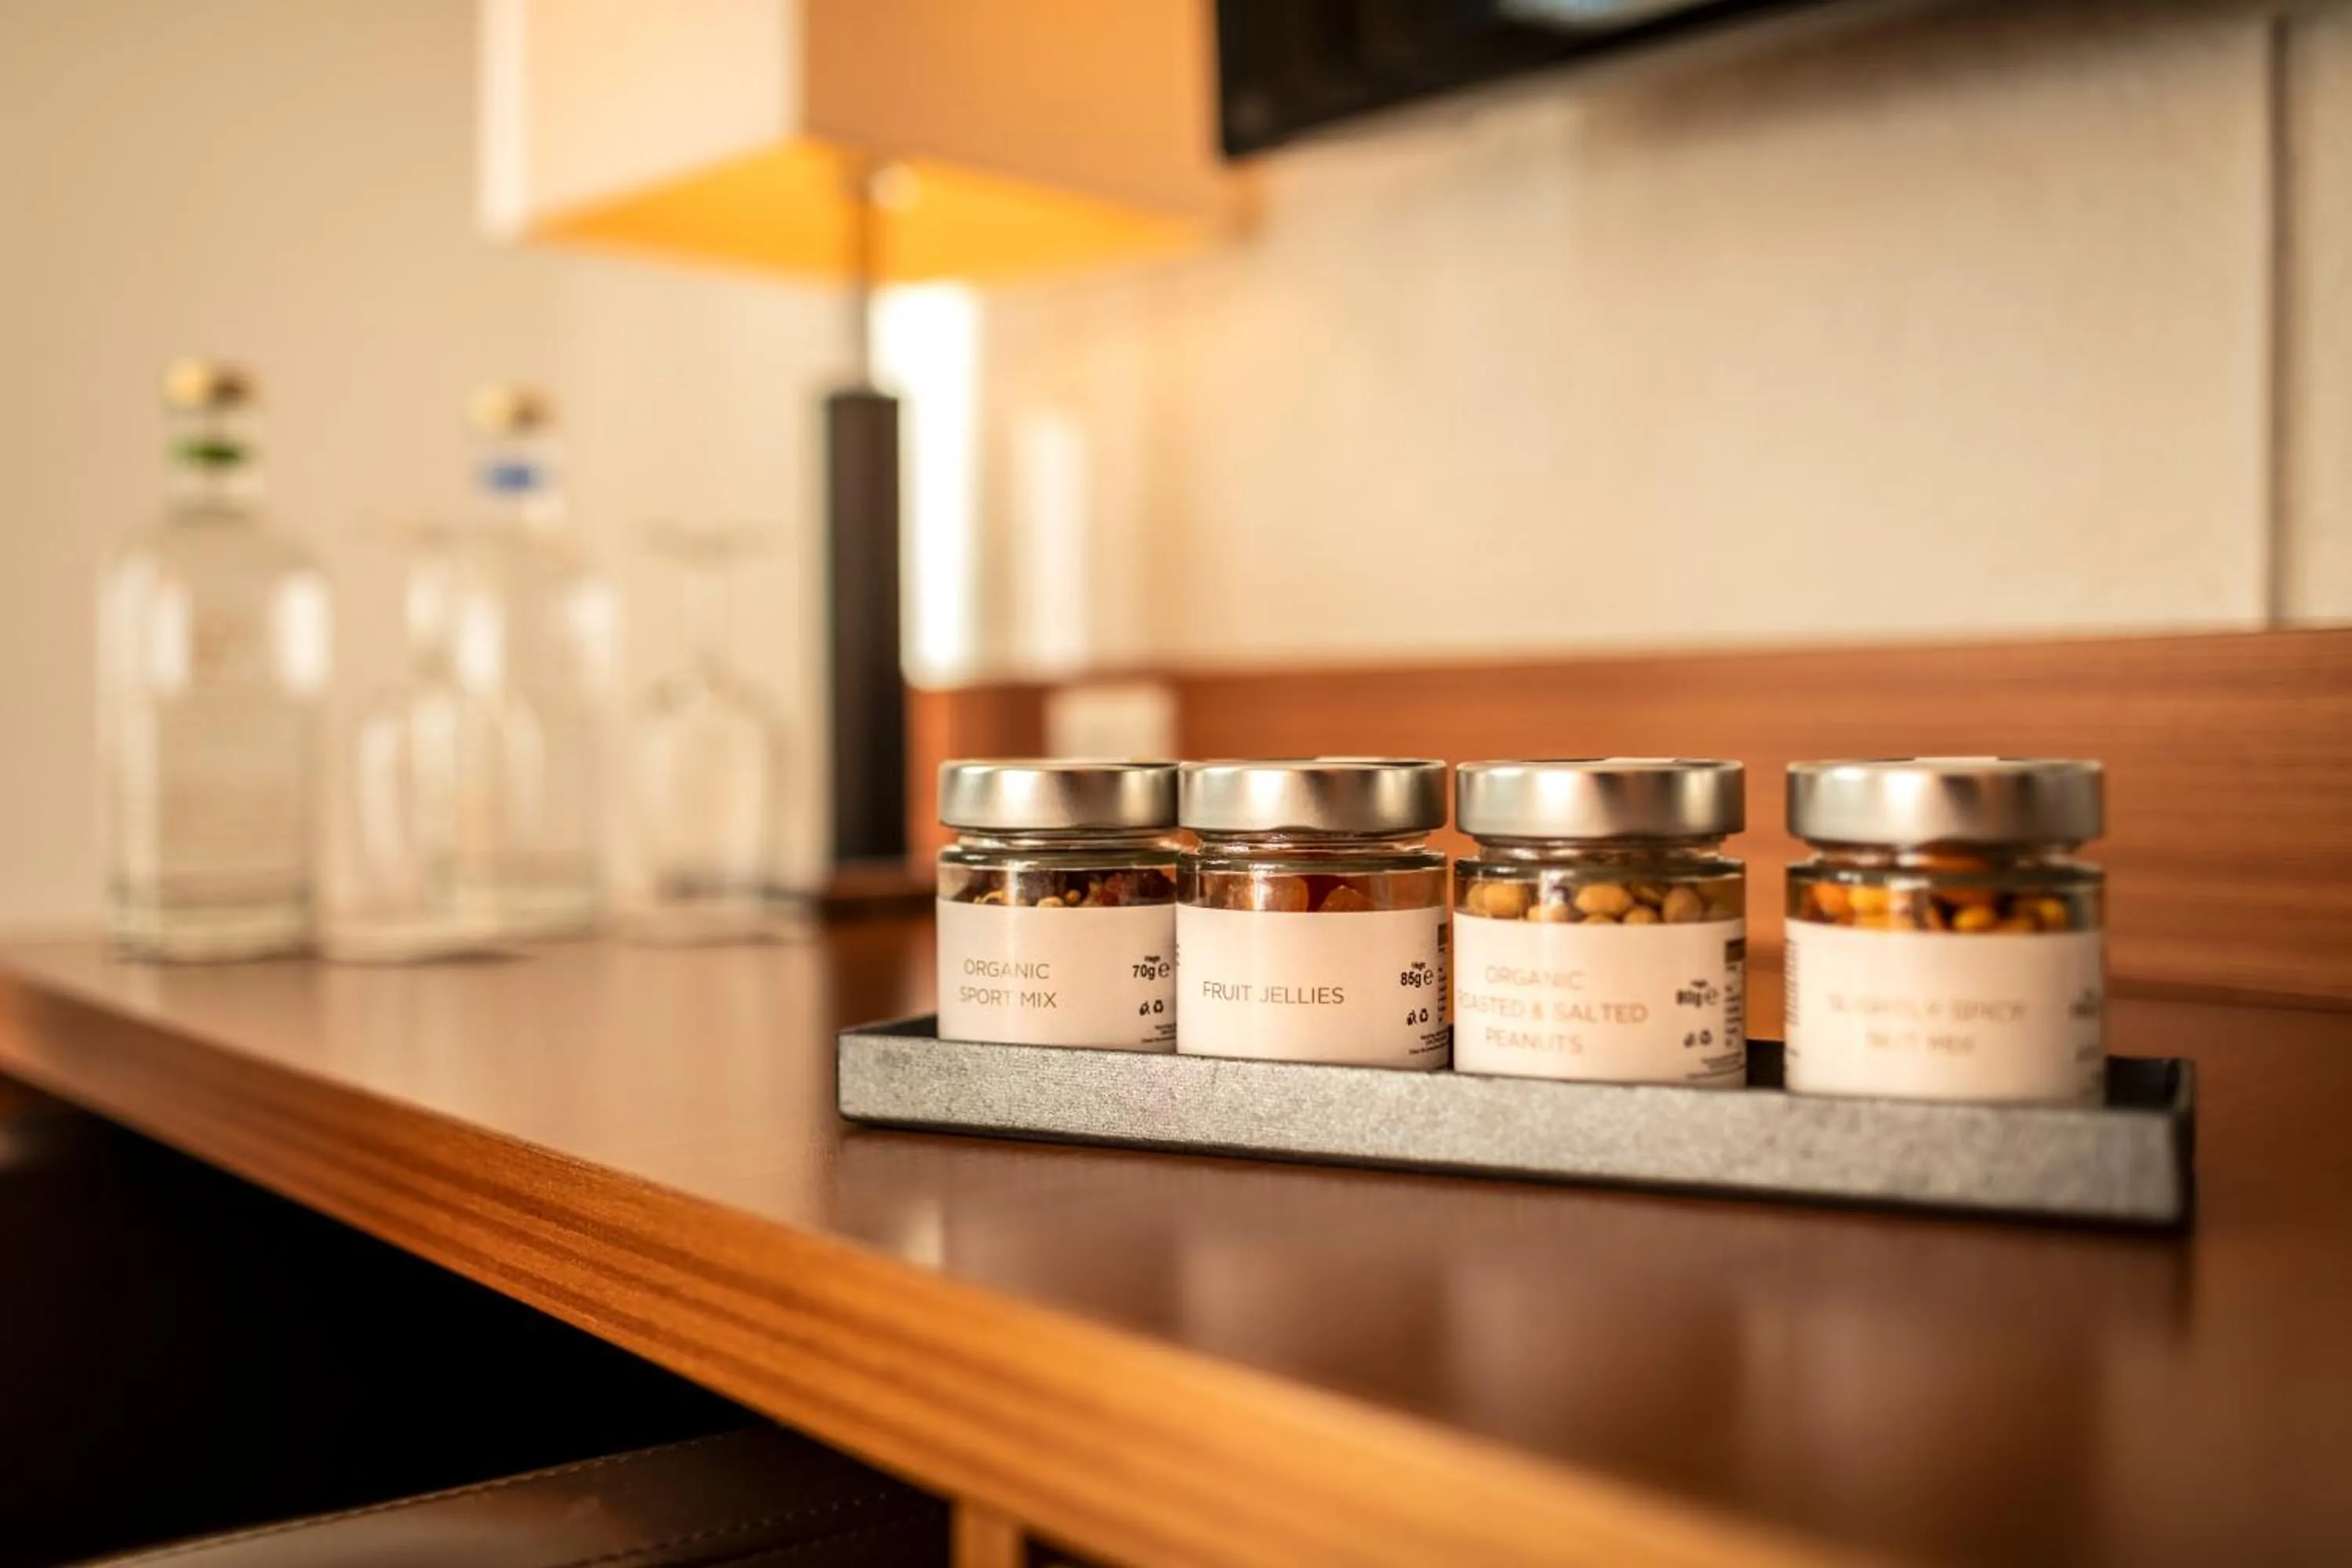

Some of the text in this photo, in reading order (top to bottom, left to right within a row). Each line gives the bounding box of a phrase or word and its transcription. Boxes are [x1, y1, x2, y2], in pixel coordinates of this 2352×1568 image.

[964, 958, 1050, 980] ORGANIC
[1132, 964, 1156, 980] 70g
[1401, 971, 1421, 989] 85g
[960, 985, 1057, 1009] SPORT MIX
[1203, 981, 1345, 1005] FRUIT JELLIES
[1554, 1001, 1649, 1024] SALTED
[1485, 1026, 1584, 1054] PEANUTS
